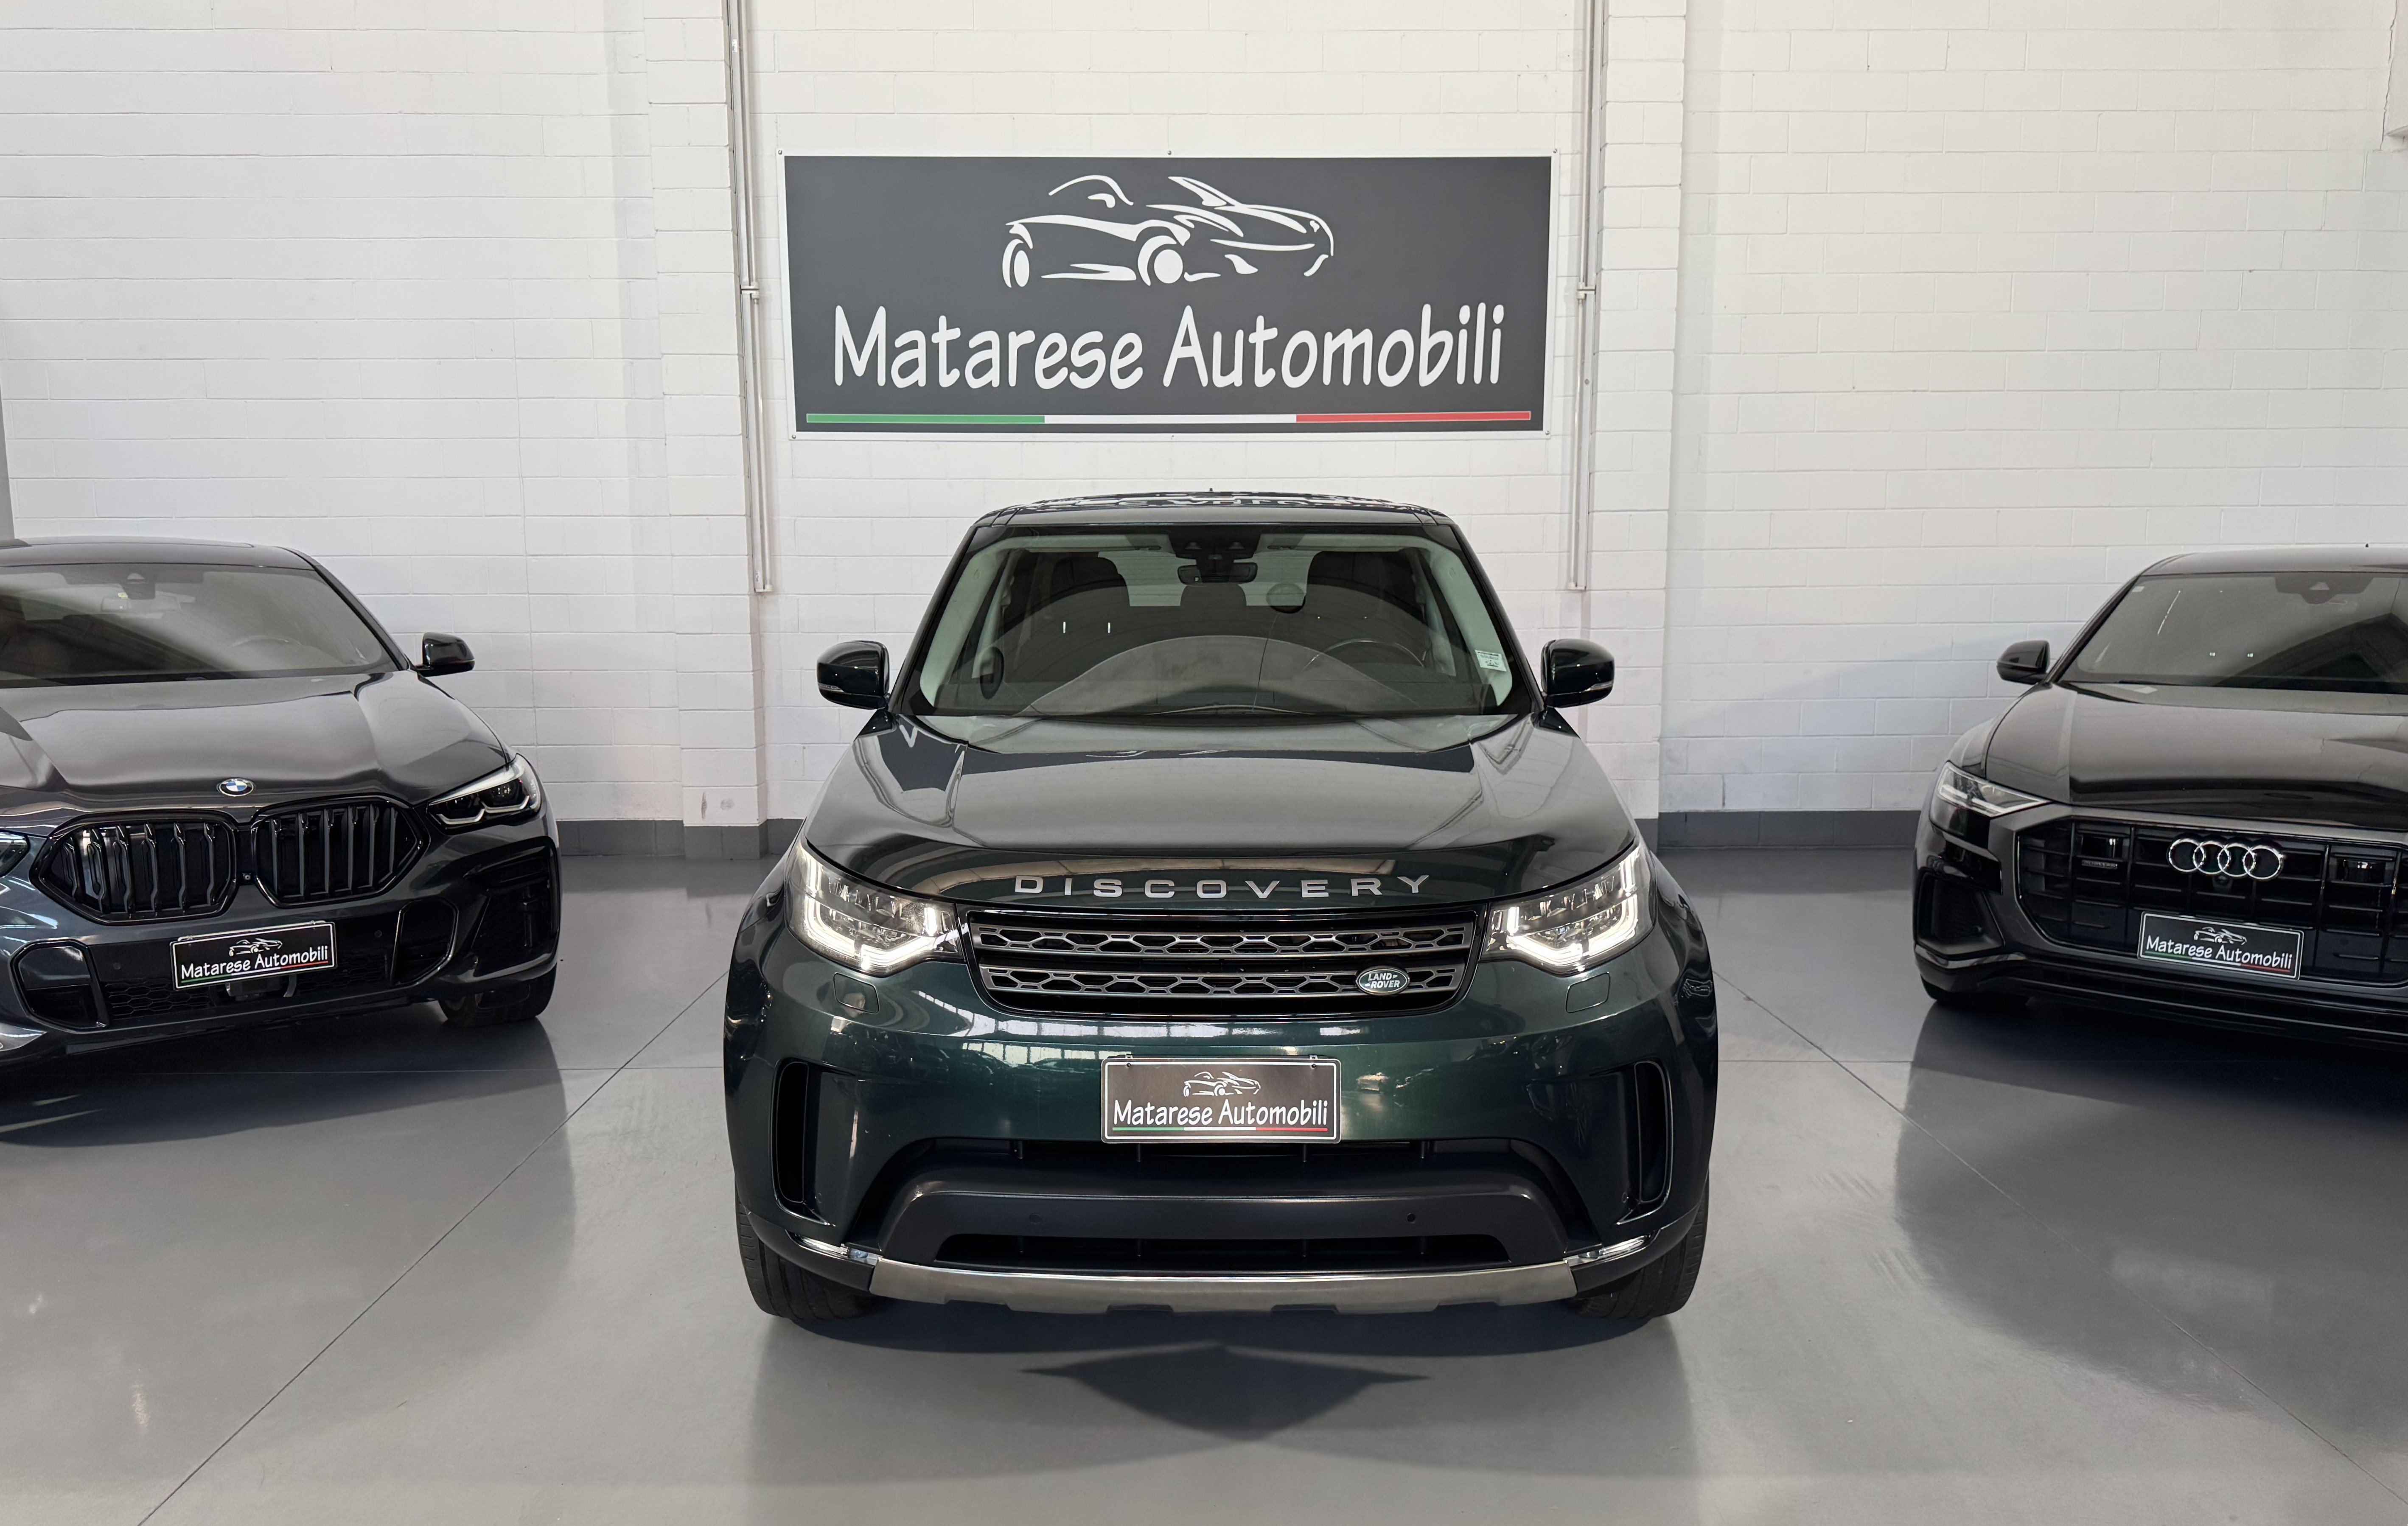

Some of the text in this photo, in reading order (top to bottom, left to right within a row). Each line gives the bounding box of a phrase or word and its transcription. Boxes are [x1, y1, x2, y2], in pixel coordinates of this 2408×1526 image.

[835, 302, 1504, 389] Matarese Automobili
[1015, 875, 1430, 899] DISCOVERY
[181, 946, 328, 979] Matarese Automobili
[2146, 935, 2292, 969] Matarese Automobili
[1368, 973, 1392, 981] LAND
[1370, 980, 1400, 988] ROVER
[1113, 1099, 1328, 1126] Matarese Automobili
